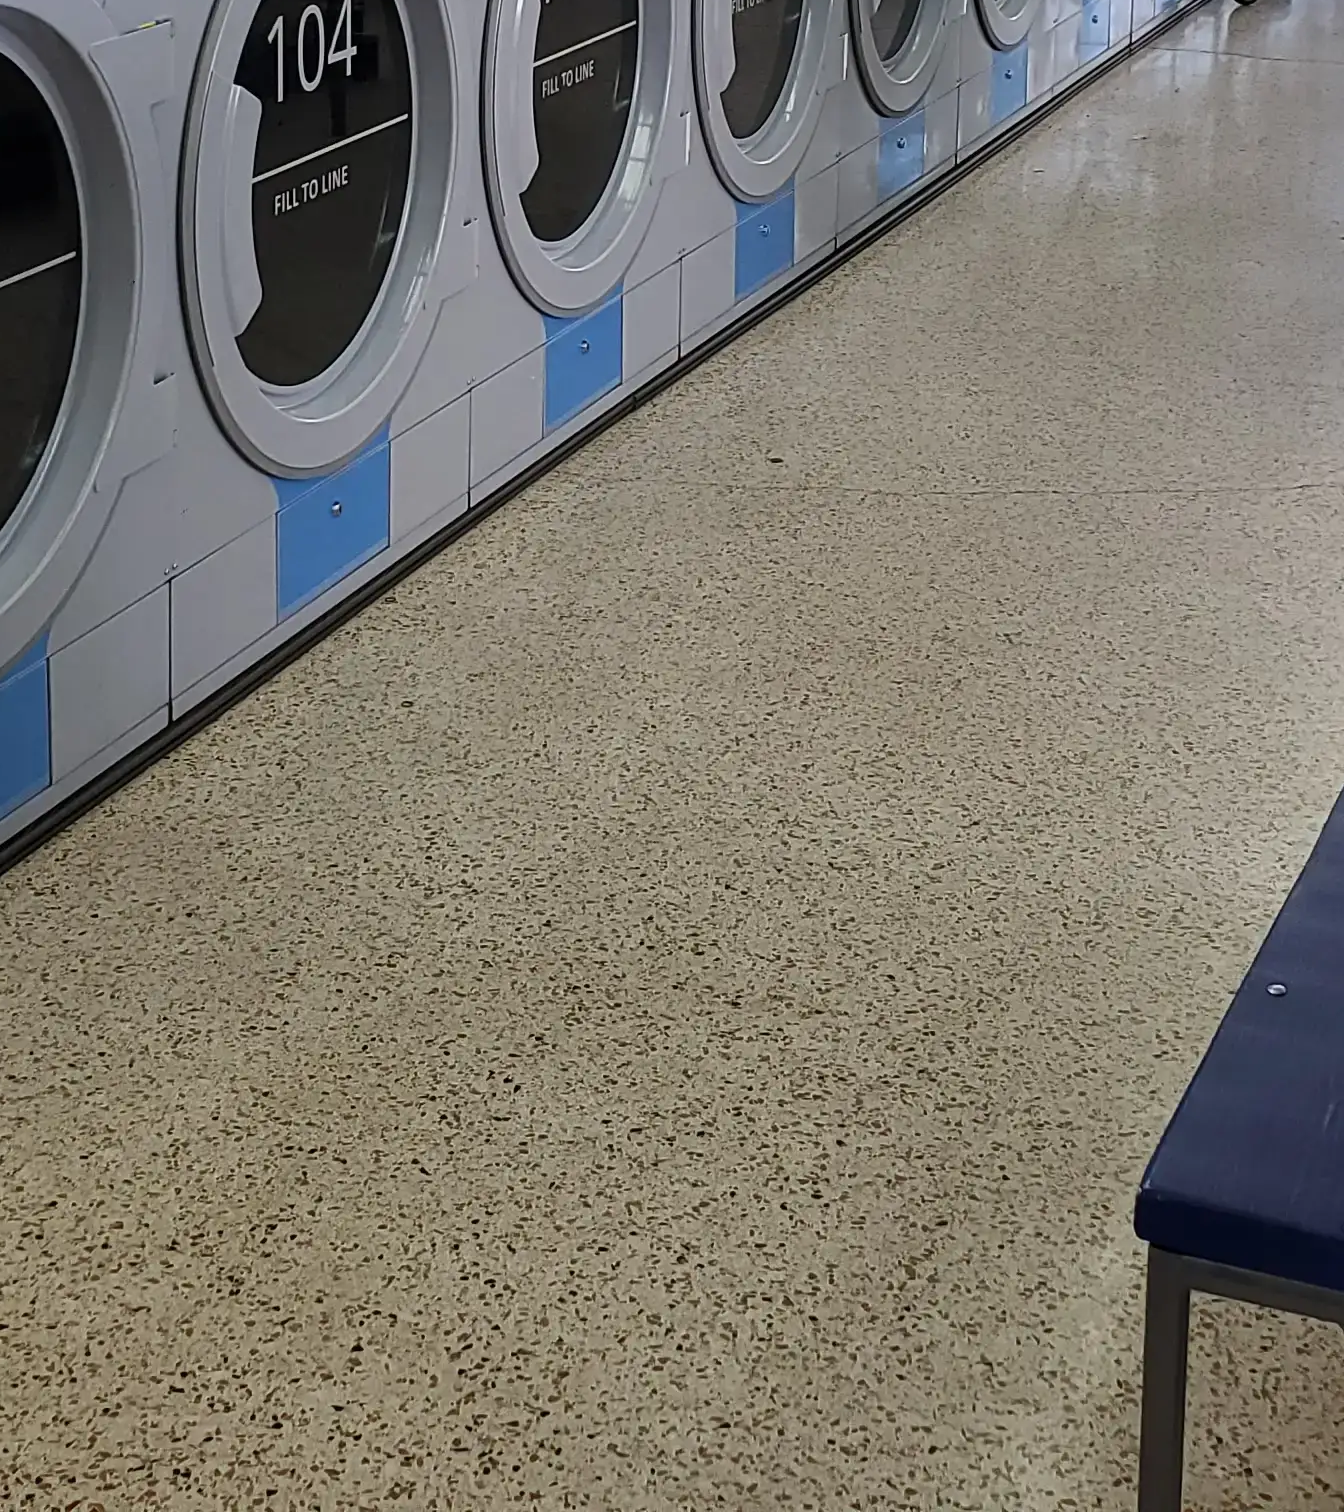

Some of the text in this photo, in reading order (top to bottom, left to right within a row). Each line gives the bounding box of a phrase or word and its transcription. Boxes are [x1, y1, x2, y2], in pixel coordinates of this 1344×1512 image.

[542, 59, 595, 99] FILL TO LINE
[274, 165, 349, 216] FILL TO LINE
